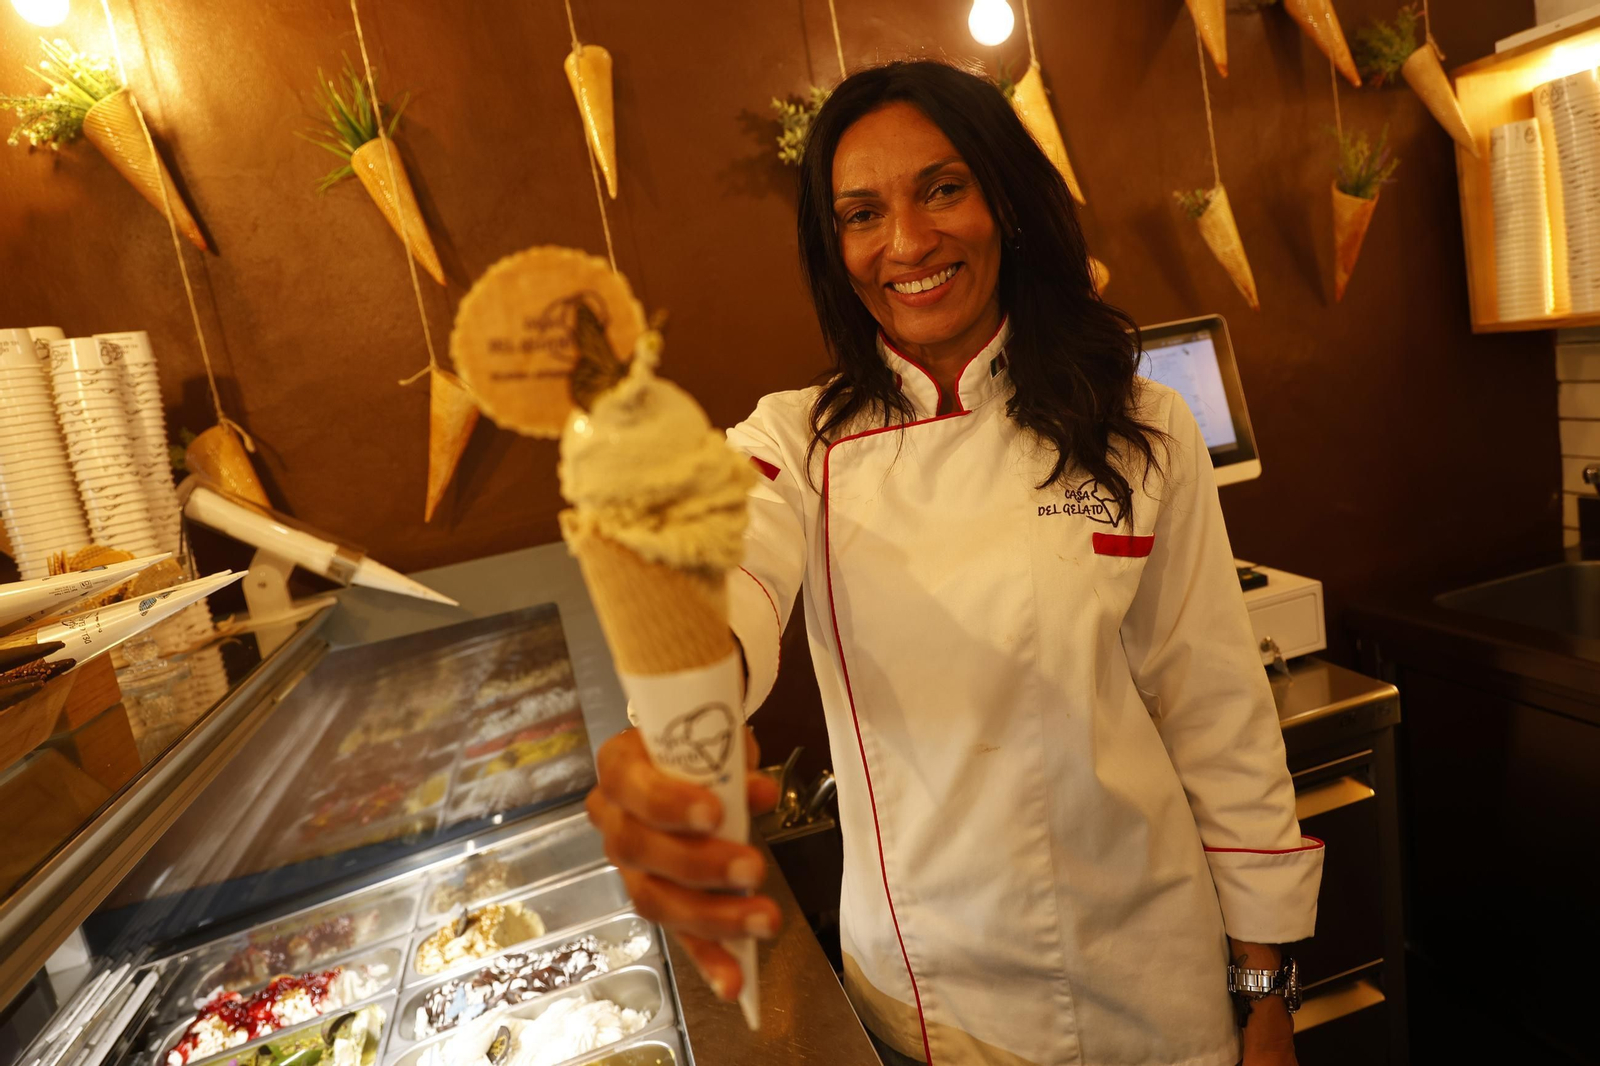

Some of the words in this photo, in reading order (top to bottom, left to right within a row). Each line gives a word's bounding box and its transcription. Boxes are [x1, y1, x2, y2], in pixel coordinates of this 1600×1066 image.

[1065, 489, 1090, 500] CASA
[1038, 504, 1061, 516] DEL
[1063, 504, 1103, 516] GELATO
